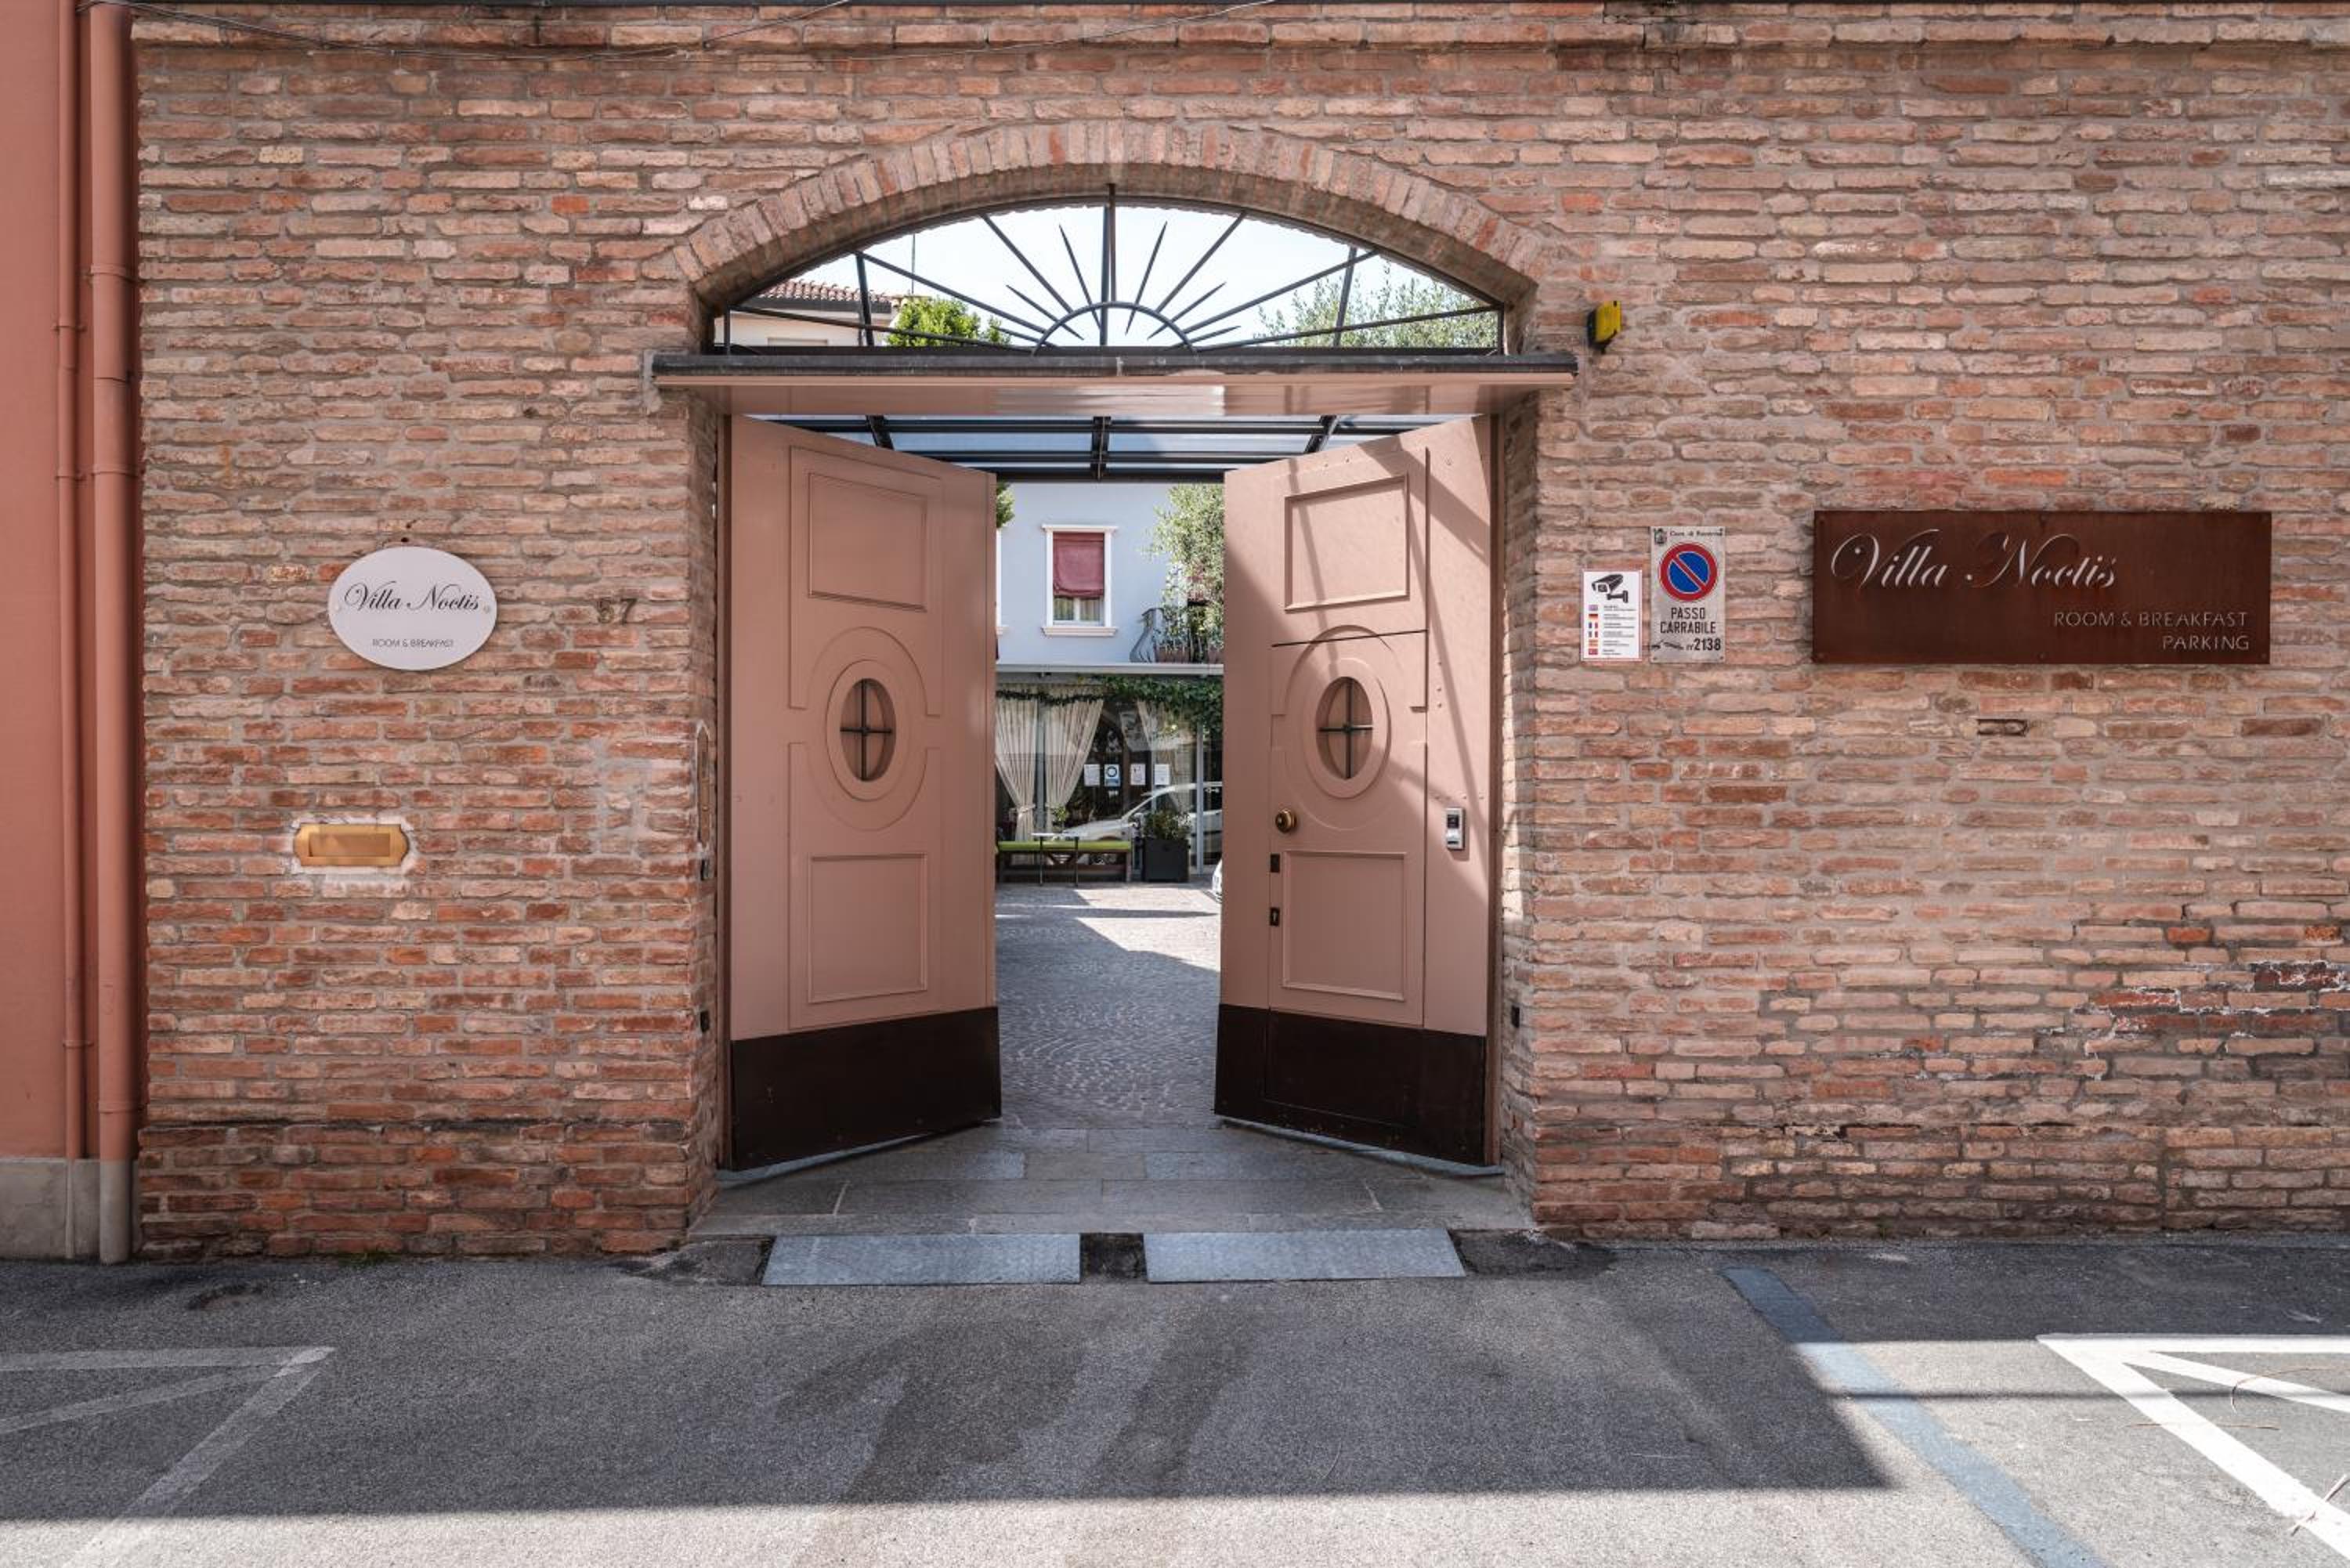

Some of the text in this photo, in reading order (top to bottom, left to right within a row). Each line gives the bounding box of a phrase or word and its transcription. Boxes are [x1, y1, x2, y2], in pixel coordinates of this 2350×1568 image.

[1831, 529, 2117, 588] Villa Noctis
[344, 580, 479, 611] Villa Noctis
[596, 598, 638, 626] 57
[1671, 607, 1705, 620] PASSO
[2055, 612, 2247, 627] ROOM & BREAKFAST
[1660, 621, 1716, 634] CARRABILE
[372, 638, 454, 648] ROOM & BREAKFAST
[2163, 634, 2250, 650] PARKING
